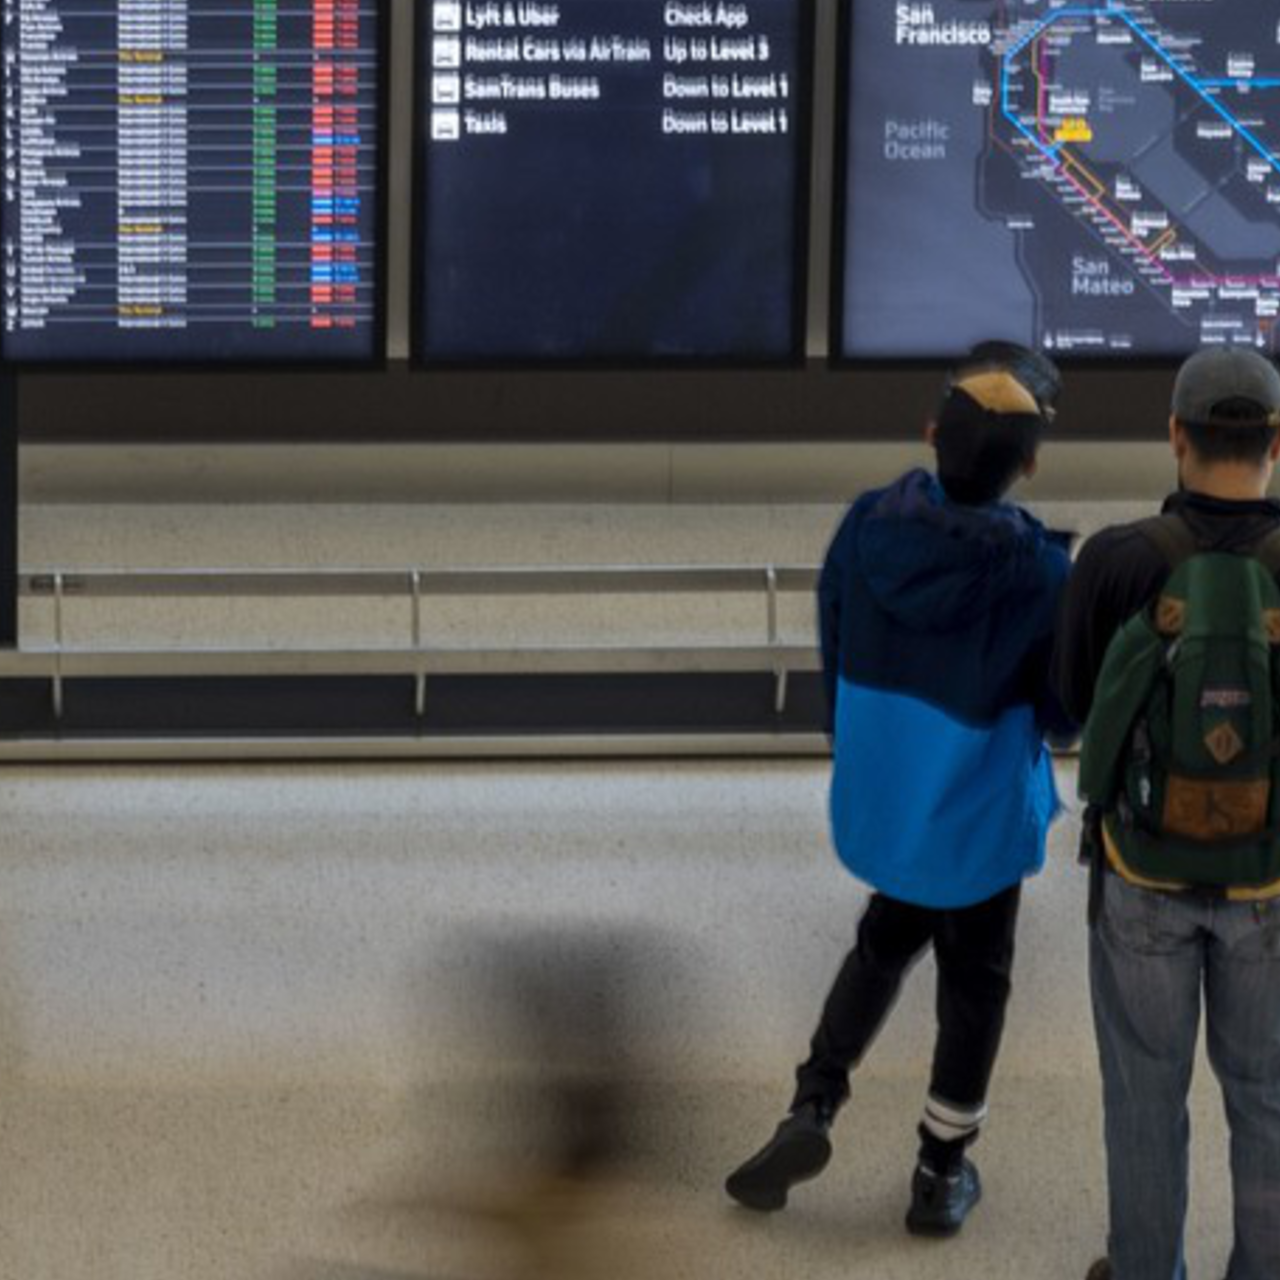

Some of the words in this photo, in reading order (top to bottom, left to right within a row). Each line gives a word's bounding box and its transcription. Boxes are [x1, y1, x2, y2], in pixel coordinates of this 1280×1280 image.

[466, 3, 502, 28] Lyft
[519, 3, 559, 26] Uber
[664, 3, 712, 26] Check
[715, 4, 748, 28] App
[896, 2, 933, 25] San
[896, 21, 991, 45] Francisco
[464, 76, 545, 99] SamTrans
[549, 76, 600, 99] Buses
[464, 112, 507, 133] Taxis
[885, 120, 949, 140] Pacific
[885, 141, 945, 160] Ocean
[1073, 256, 1109, 275] San
[1072, 277, 1133, 295] Mateo
